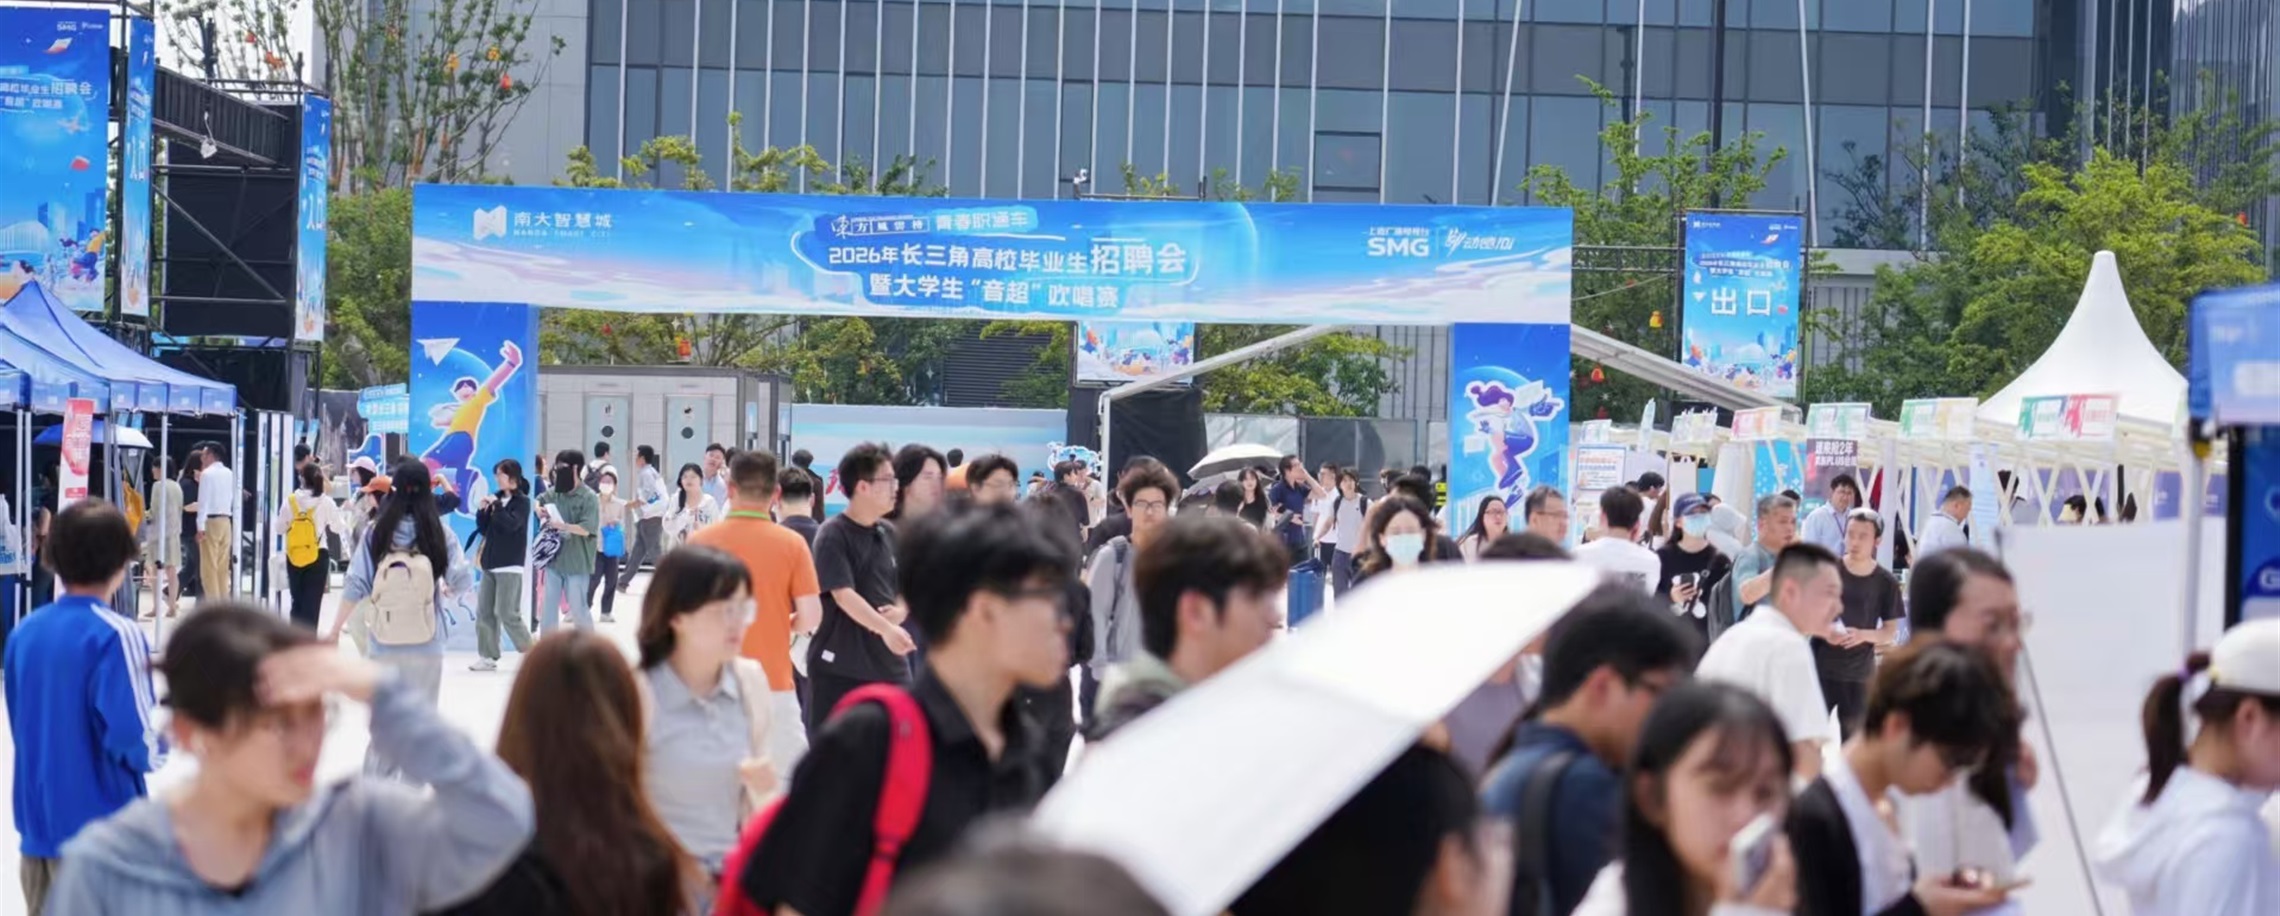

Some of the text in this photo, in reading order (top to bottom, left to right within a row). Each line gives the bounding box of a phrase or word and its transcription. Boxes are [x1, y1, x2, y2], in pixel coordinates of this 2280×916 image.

[514, 212, 612, 228] 南大智慧城
[829, 243, 1186, 275] 2026年长三角高校毕业生招聘会
[1368, 237, 1429, 257] SMG
[1711, 287, 1770, 315] 出口
